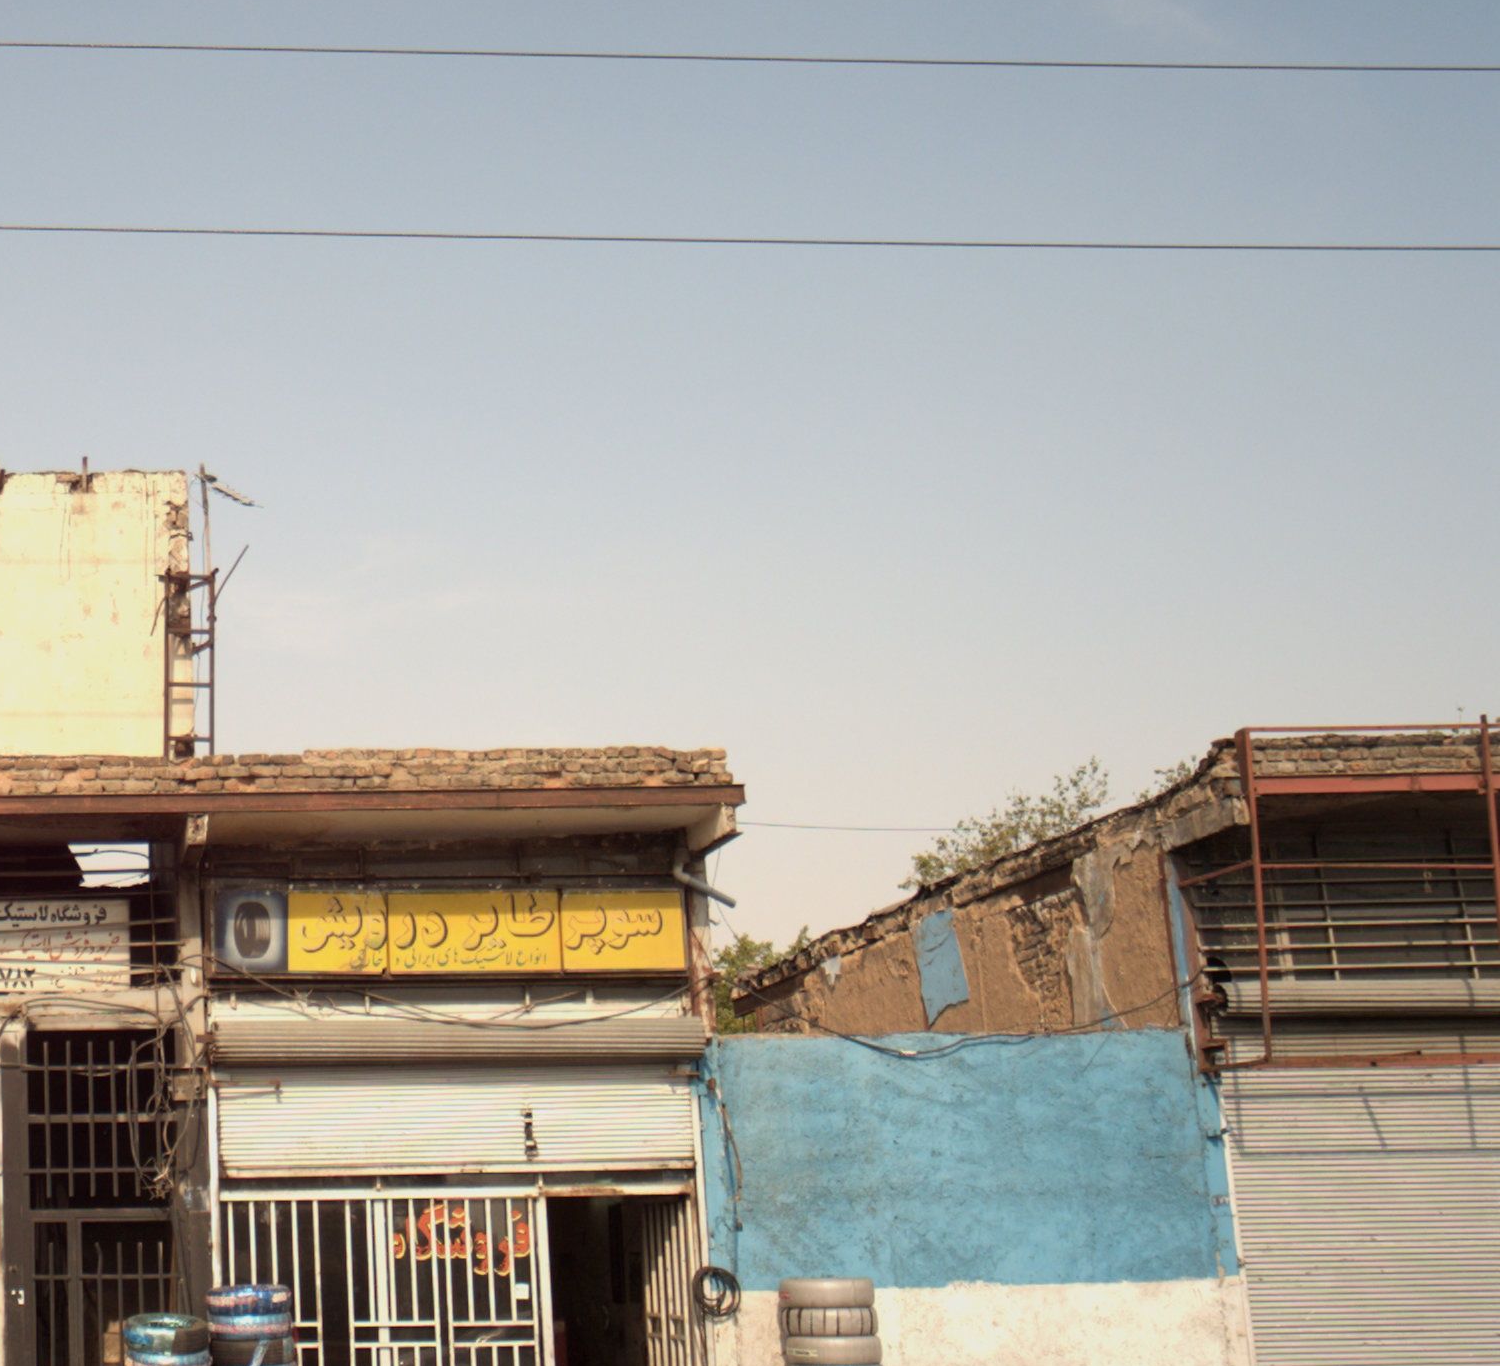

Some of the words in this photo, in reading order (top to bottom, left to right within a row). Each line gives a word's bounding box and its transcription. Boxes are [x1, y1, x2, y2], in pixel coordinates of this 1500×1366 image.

[51, 903, 107, 925] فروشگاه
[301, 896, 450, 953] درویش
[565, 906, 663, 955] سوپر
